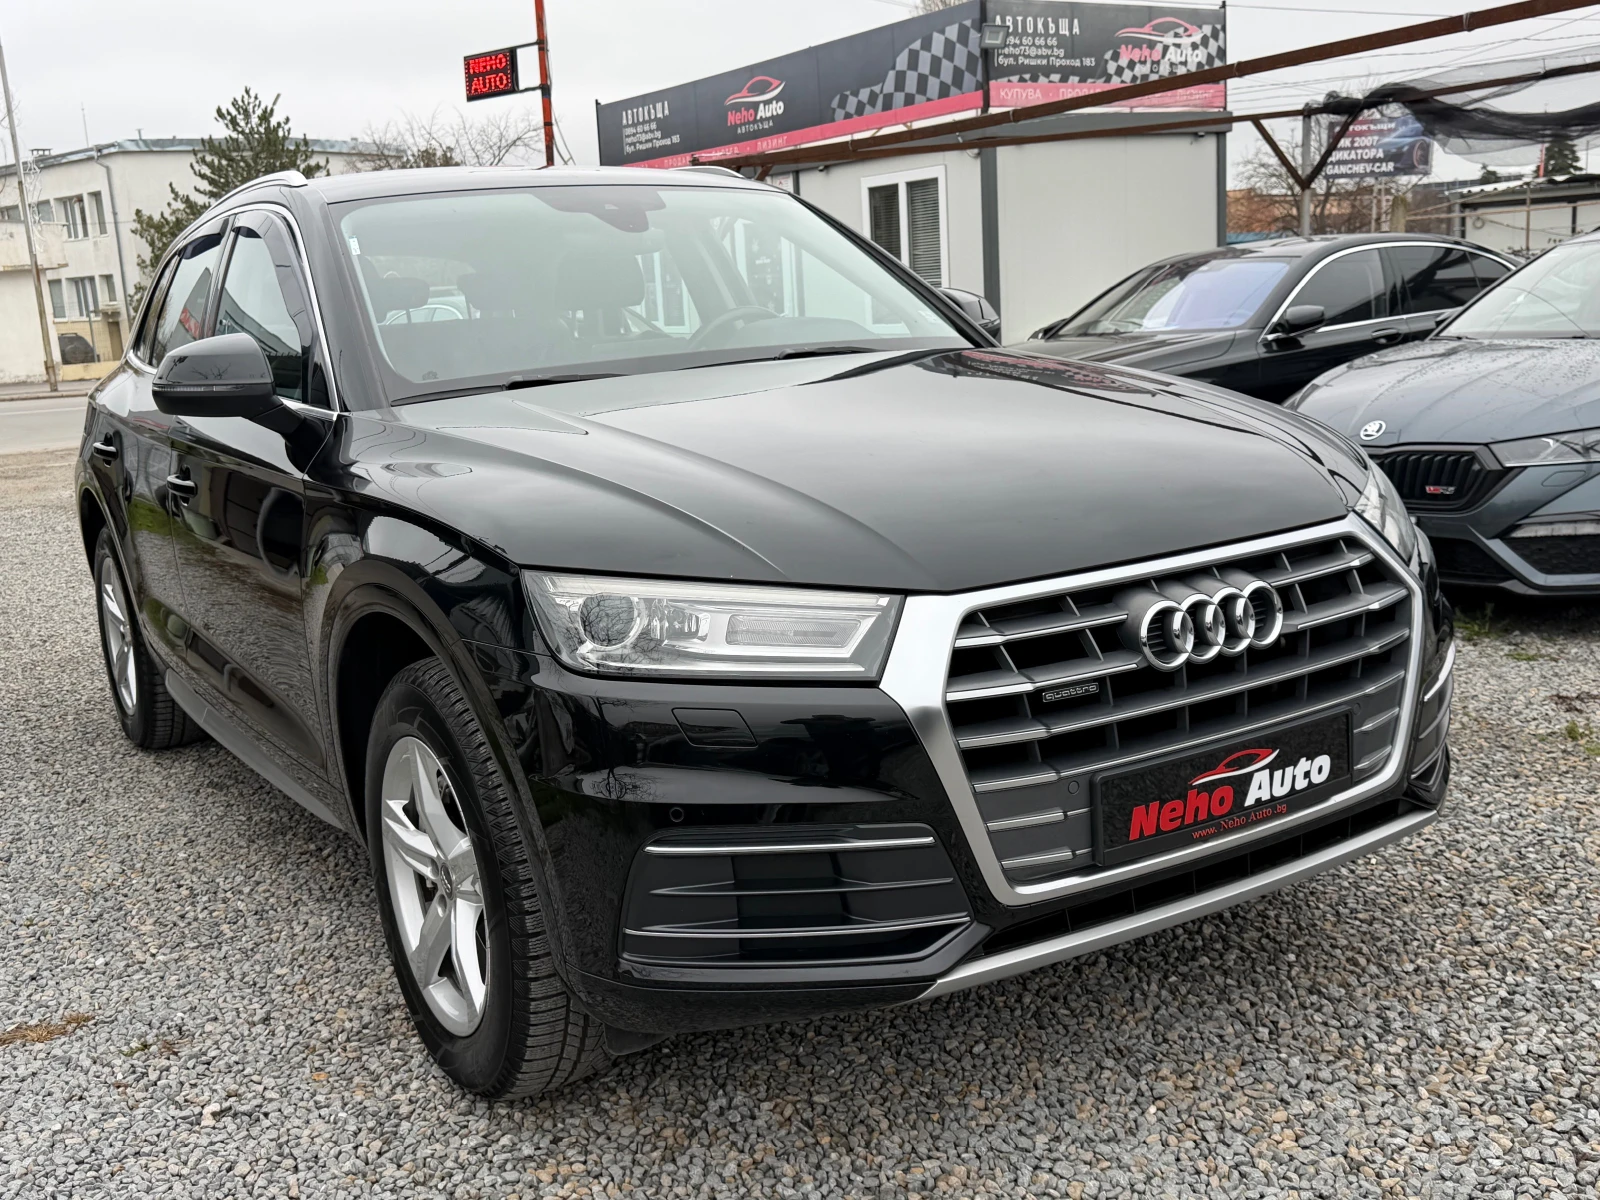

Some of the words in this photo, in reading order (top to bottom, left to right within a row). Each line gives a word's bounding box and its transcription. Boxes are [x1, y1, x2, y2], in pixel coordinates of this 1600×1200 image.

[995, 14, 1080, 36] АВТОКЪЩА
[1022, 37, 1033, 45] 60
[1034, 37, 1045, 45] 66
[1047, 37, 1058, 46] 66
[998, 56, 1016, 67] бул.
[1018, 57, 1048, 66] Ришки
[1049, 57, 1081, 67] Проход
[1082, 57, 1096, 67] 183
[1119, 44, 1162, 62] Neho
[1164, 45, 1202, 62] Auto
[469, 54, 507, 74] NEHO
[471, 73, 507, 94] AUTO
[1000, 88, 1042, 99] КУПУВА
[622, 101, 670, 126] АВТОКЪЩА
[727, 107, 756, 126] Neho
[756, 100, 784, 120] Auto
[737, 120, 774, 134] АВТОКЪЩА
[756, 136, 788, 152] ЛИЗИНГ
[1353, 136, 1379, 148] 2007
[1045, 683, 1098, 701] quattro
[1128, 785, 1234, 841] Neho
[1243, 754, 1331, 807] Auto
[1219, 815, 1247, 832] Neho
[1248, 806, 1272, 822] Auto
